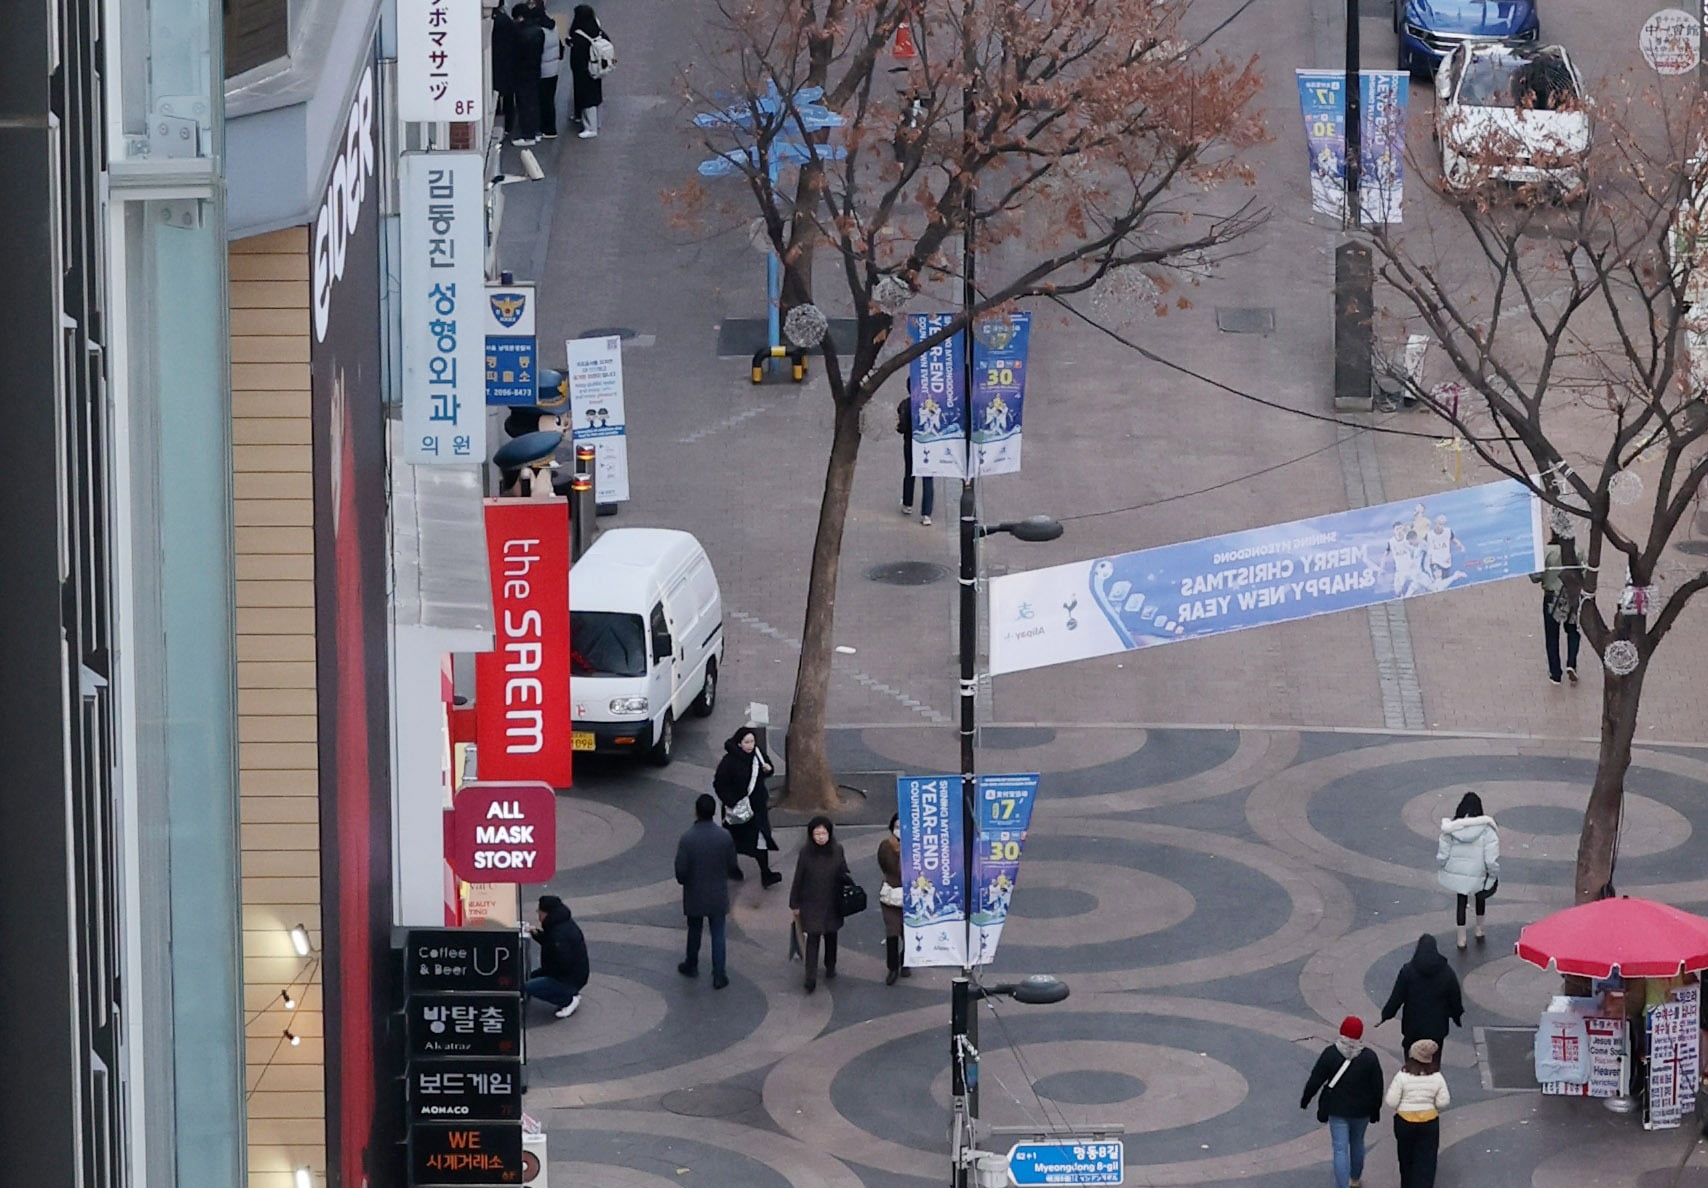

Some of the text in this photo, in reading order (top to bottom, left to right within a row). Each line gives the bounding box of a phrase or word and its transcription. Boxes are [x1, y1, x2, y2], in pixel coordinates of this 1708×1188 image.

[429, 0, 449, 100] ボマサーヅ
[455, 100, 474, 115] 8F
[314, 66, 373, 344] EIDER
[428, 170, 455, 268] 김동진
[428, 283, 462, 425] 성형외과
[928, 315, 944, 393] YER-END
[503, 538, 545, 755] the SAEM
[486, 801, 524, 819] ALL
[476, 825, 534, 844] MASK
[922, 781, 939, 871] YEAR-END
[474, 851, 537, 869] STORY
[990, 841, 1020, 861] 30
[418, 947, 467, 959] Coffee
[434, 963, 468, 976] Beer
[423, 1006, 505, 1034] 방탈출
[419, 1073, 512, 1094] 보드게임
[421, 1106, 469, 1114] MONACO
[448, 1131, 481, 1148] WE
[1034, 1162, 1096, 1174] Myeongdong
